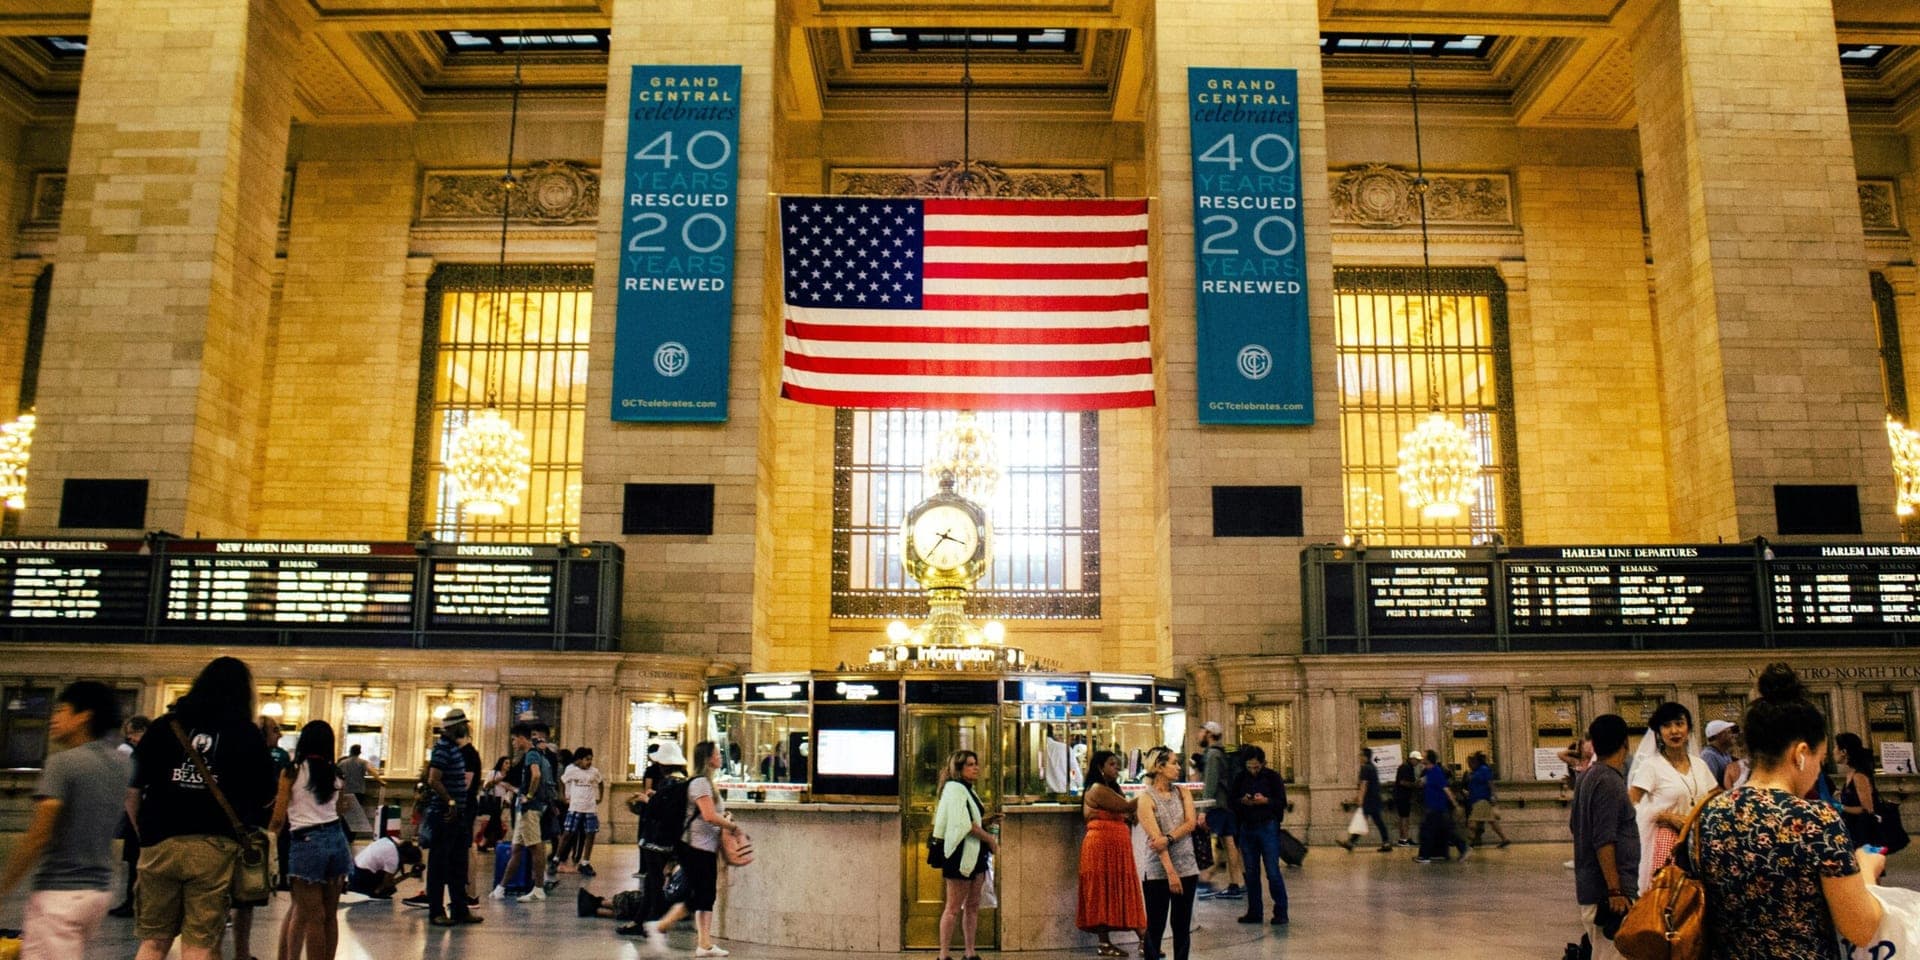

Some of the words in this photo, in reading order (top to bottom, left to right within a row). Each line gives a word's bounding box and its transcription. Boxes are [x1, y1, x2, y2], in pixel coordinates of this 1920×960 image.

[650, 77, 719, 88] GRAND
[1208, 80, 1276, 90] GRAND
[640, 91, 732, 102] CENTRAL
[1198, 94, 1290, 104] CENTRAL
[634, 100, 737, 121] celebrates
[1194, 103, 1294, 124] celebrates
[634, 131, 731, 170] 40
[1198, 133, 1294, 172] 40
[634, 172, 729, 190] YEARS
[1201, 174, 1295, 193] YEARS
[631, 194, 729, 207] RESCUED
[1200, 196, 1297, 210] RESCUED
[628, 212, 727, 253] 20
[1202, 215, 1296, 256] 20
[628, 256, 726, 274] YEARS
[1203, 258, 1300, 277] YEARS
[625, 278, 724, 291] RENEWED
[1203, 281, 1300, 294] RENEWED
[622, 399, 717, 408] GCTcelebrates.com
[1209, 402, 1303, 411] GCTcelebrates.com
[217, 544, 242, 553] NEW
[243, 544, 278, 553] HAVEN
[281, 544, 305, 553] LINE
[307, 544, 370, 553] DEPARTURES
[457, 546, 533, 556] INFORMATION
[1391, 549, 1466, 558] INFORMATION
[1562, 549, 1606, 558] HARLEM
[1608, 549, 1633, 558] LINE
[1635, 549, 1698, 558] DEPARTURES
[1822, 547, 1864, 556] HARLEM
[1867, 547, 1890, 556] LINE
[918, 647, 996, 661] Information
